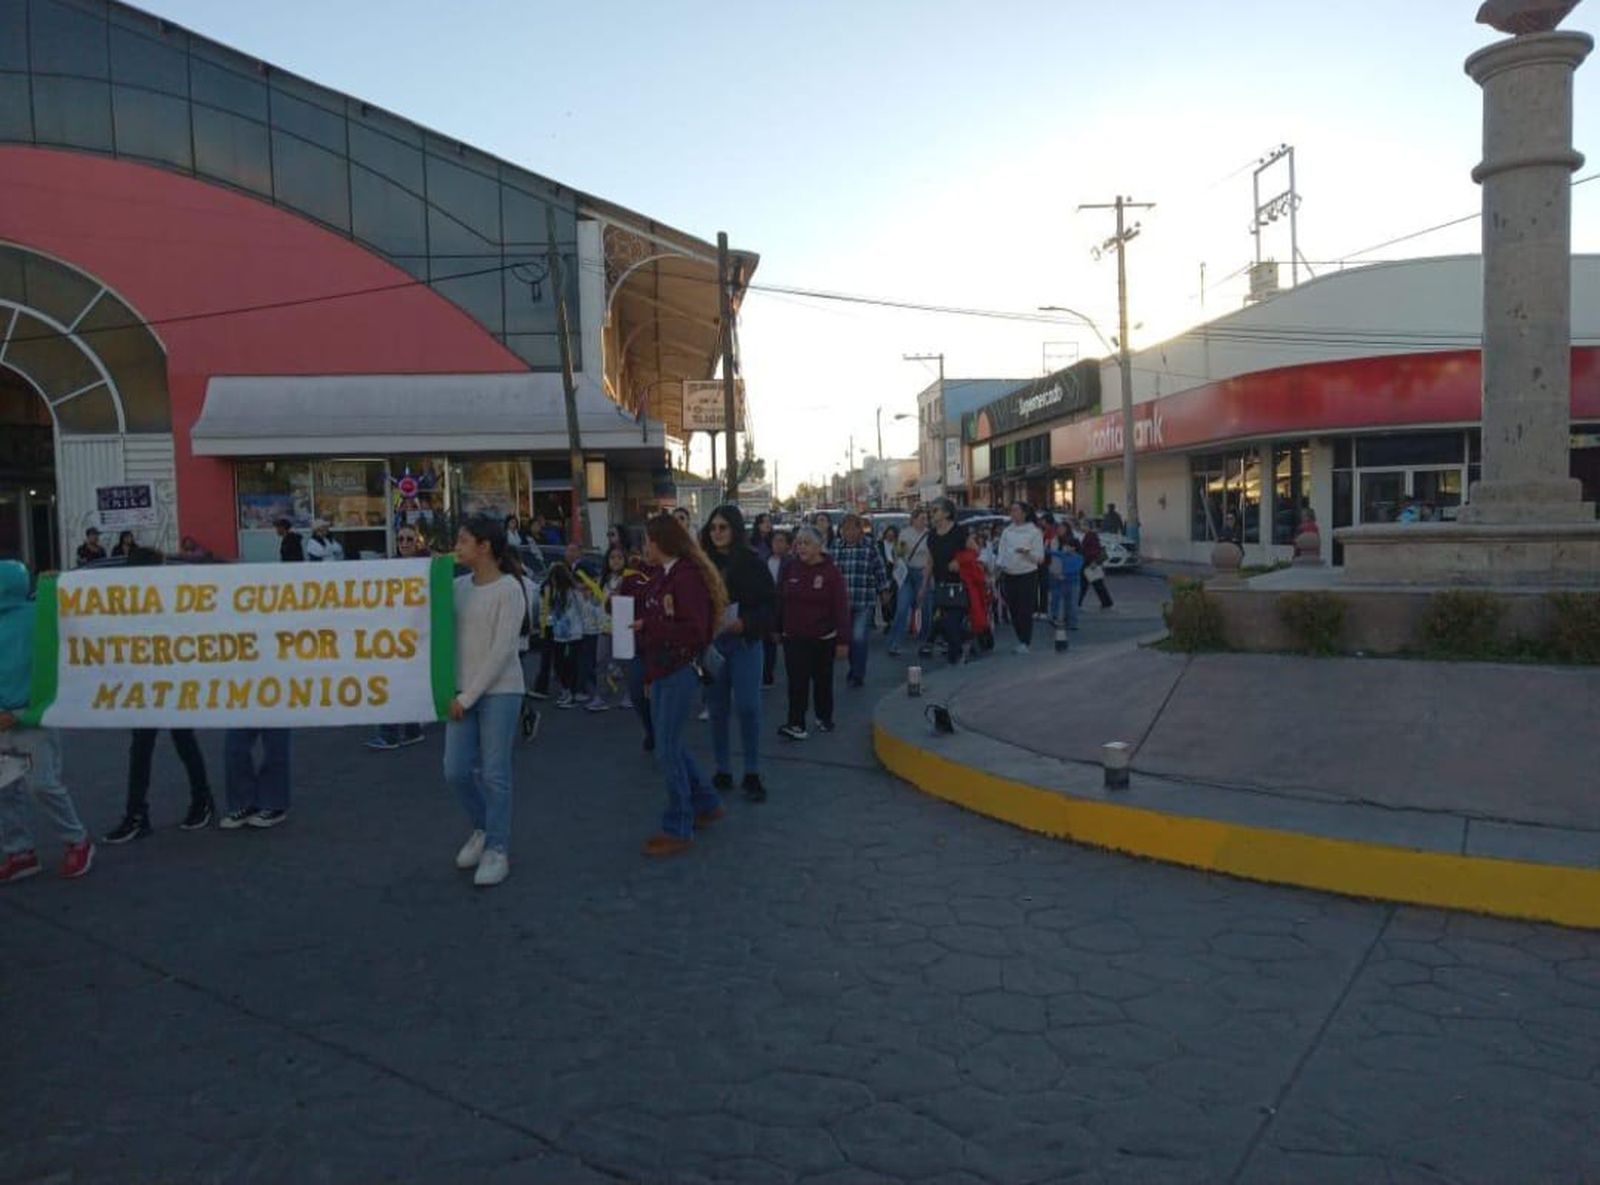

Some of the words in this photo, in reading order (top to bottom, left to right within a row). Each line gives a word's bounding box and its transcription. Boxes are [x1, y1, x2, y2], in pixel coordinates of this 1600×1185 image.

[58, 584, 164, 616] MARIA
[175, 584, 218, 614] DE
[233, 576, 427, 613] GUADALUPE
[67, 632, 259, 666] INTERCEDE
[276, 629, 340, 661] POR
[354, 628, 418, 659] LOS
[91, 676, 390, 711] MATRIMONIOS
